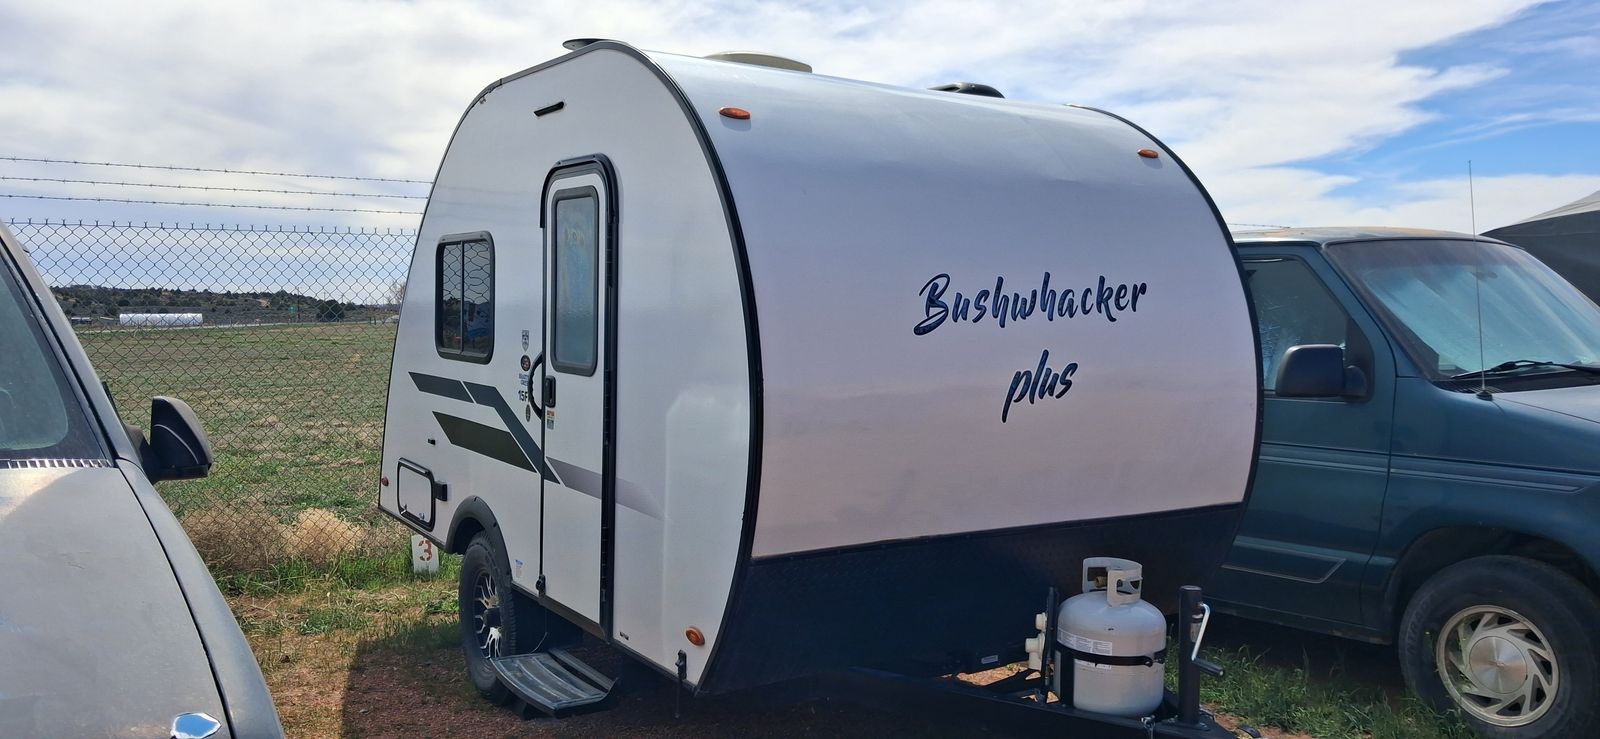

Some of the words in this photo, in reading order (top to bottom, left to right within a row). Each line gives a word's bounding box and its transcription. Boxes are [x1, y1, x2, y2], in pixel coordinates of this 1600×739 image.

[913, 271, 1147, 336] Bushwhacker
[1001, 349, 1078, 423] plus
[418, 540, 432, 561] 3
